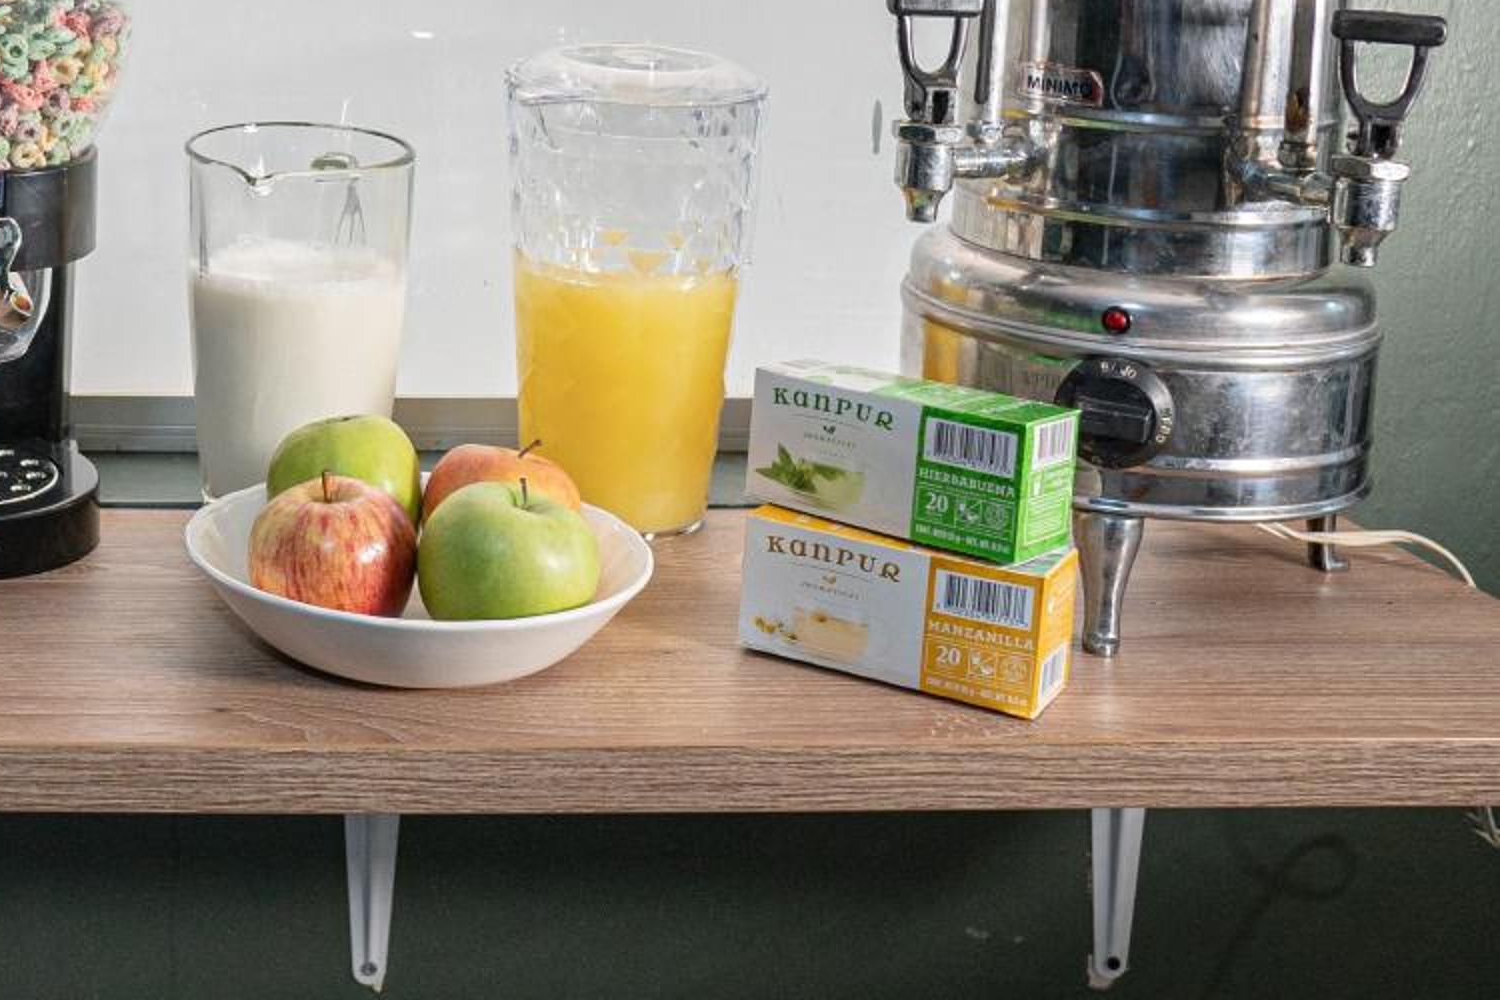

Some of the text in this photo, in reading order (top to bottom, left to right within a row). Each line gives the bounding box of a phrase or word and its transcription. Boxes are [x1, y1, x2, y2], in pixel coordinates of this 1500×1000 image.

[919, 466, 1016, 499] HIERBABUENA
[925, 490, 950, 514] 20
[930, 620, 1035, 651] MANZANILLA
[936, 643, 962, 666] 20
